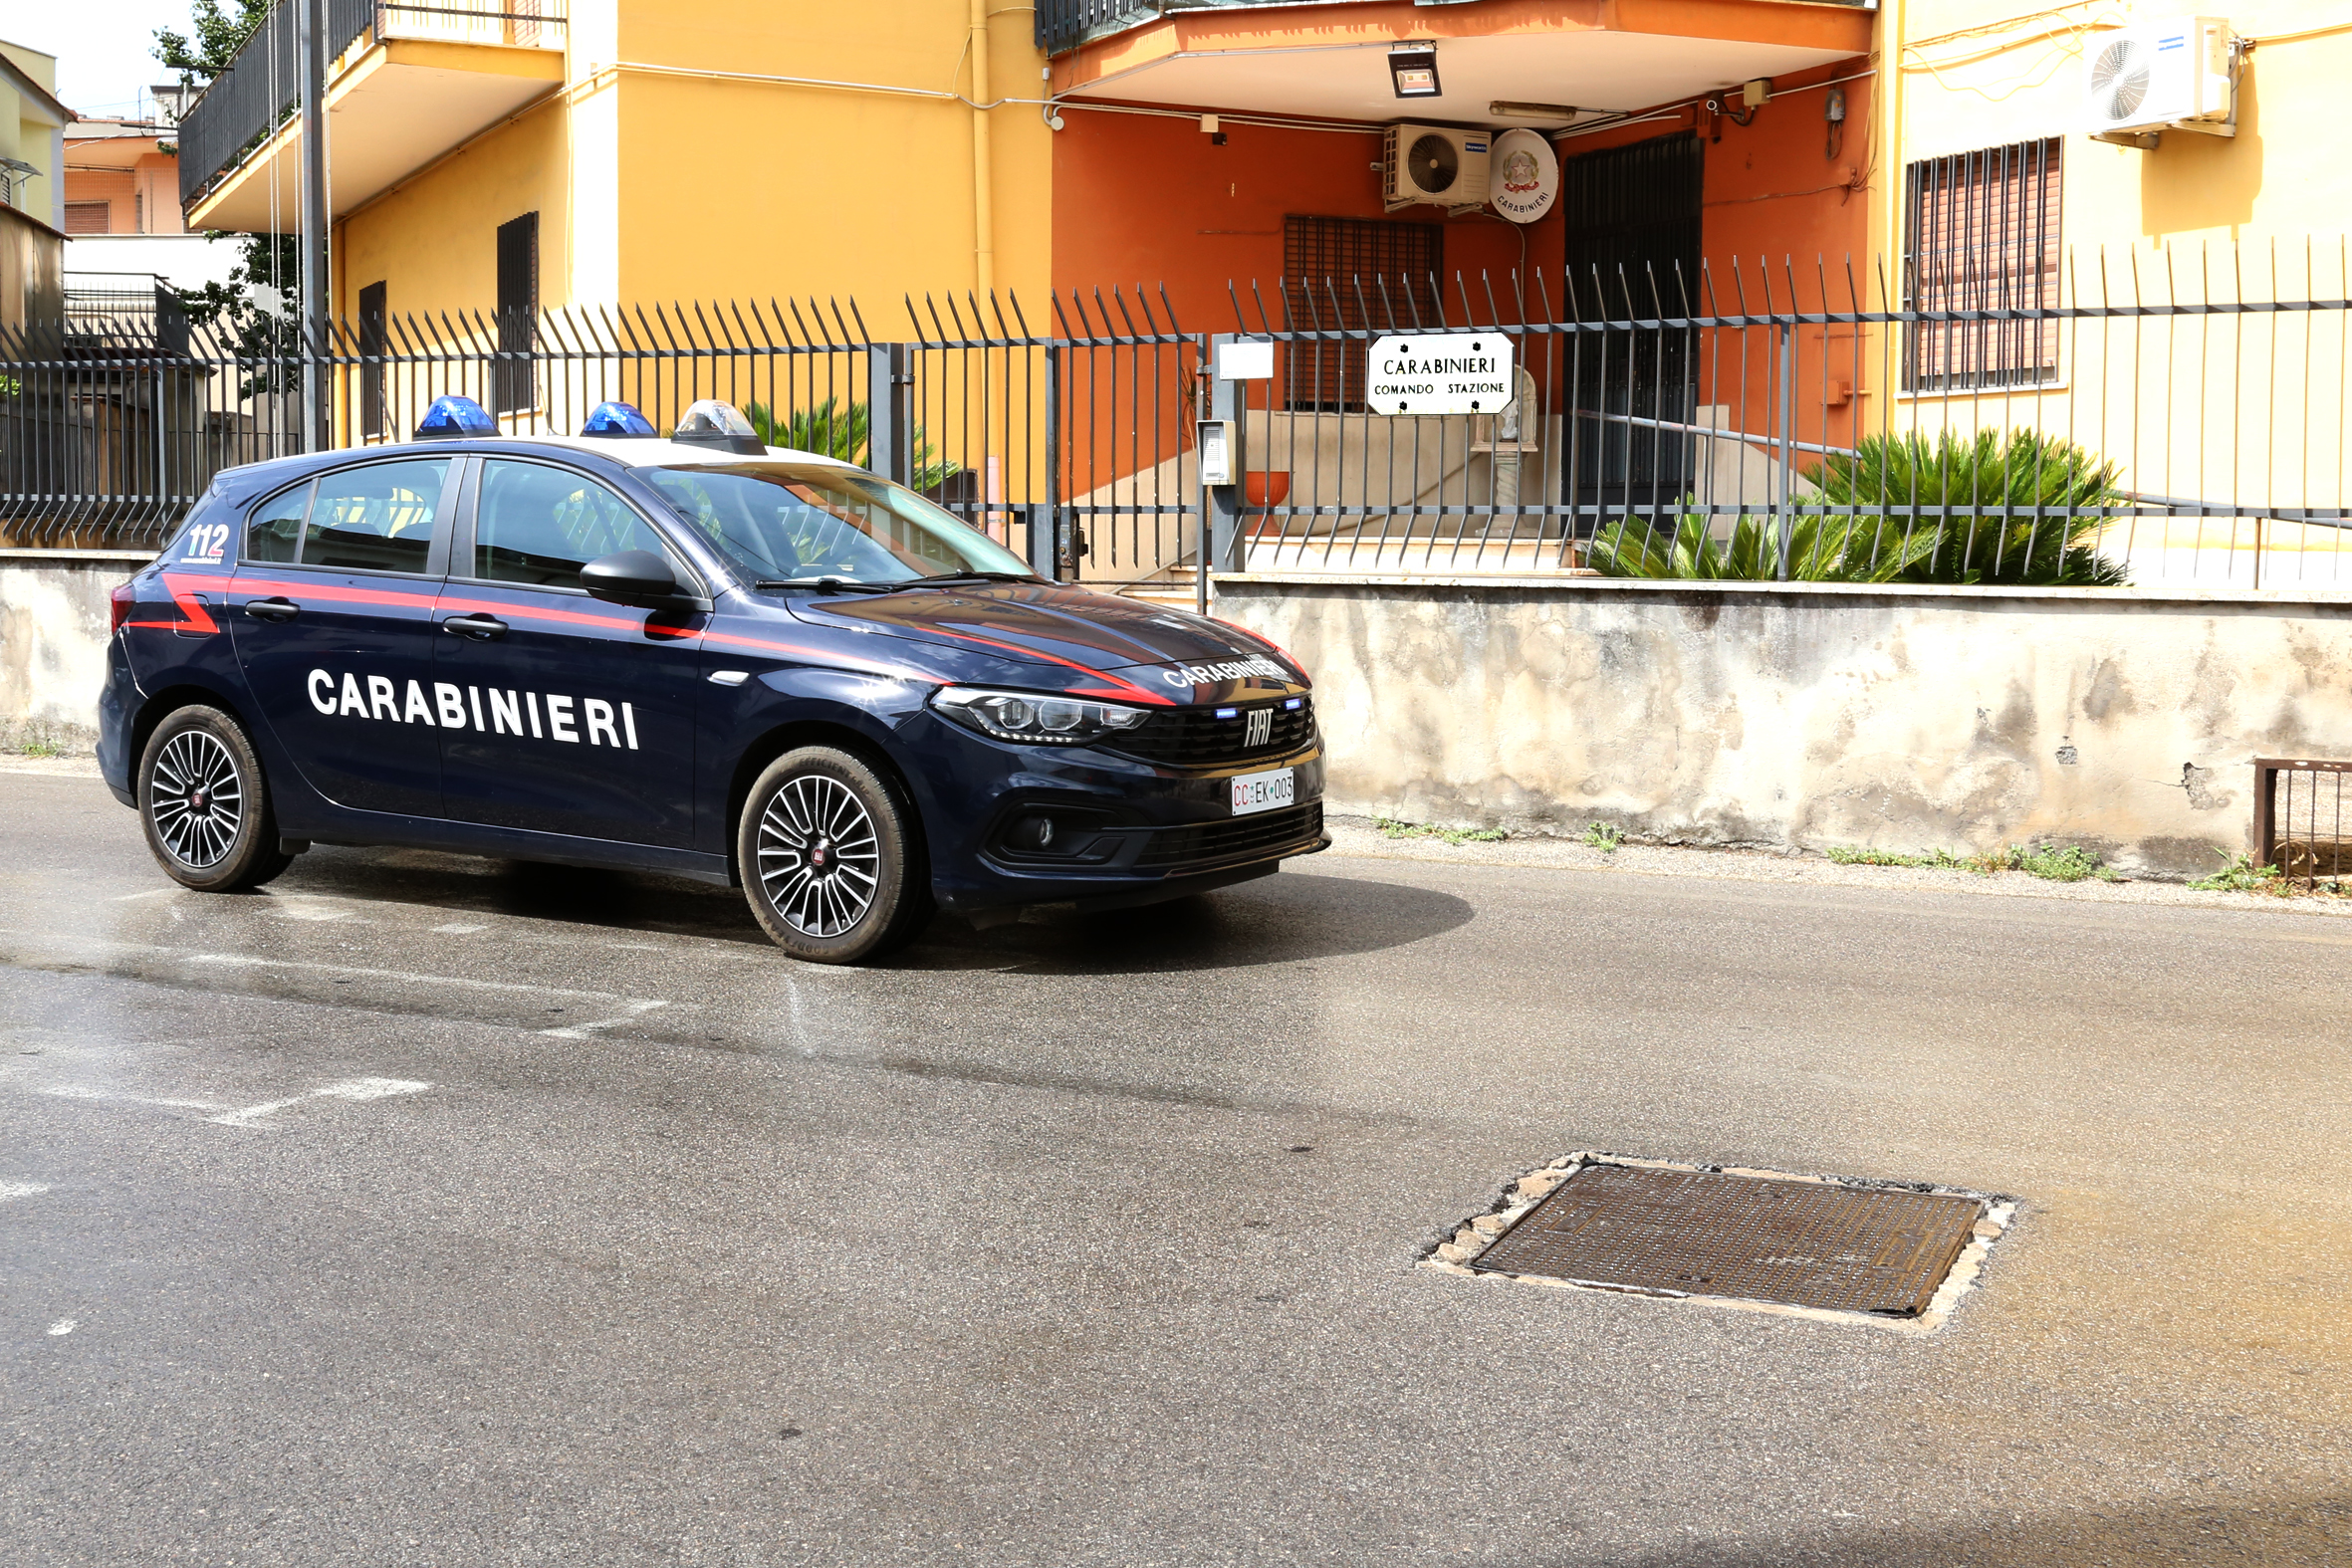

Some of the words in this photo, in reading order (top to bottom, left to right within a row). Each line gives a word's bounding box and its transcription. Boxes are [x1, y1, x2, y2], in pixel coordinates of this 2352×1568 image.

[1497, 192, 1549, 213] CARABINIERI
[1384, 357, 1496, 374] CARABINIERI
[1374, 384, 1434, 394] COMANDO
[1448, 382, 1505, 393] STAZIONE
[188, 524, 229, 557] 112
[1163, 660, 1288, 688] CARABINIERI
[308, 669, 638, 750] CARABINIERI
[1245, 708, 1273, 747] FIAT
[799, 757, 852, 778] EFFICIENT
